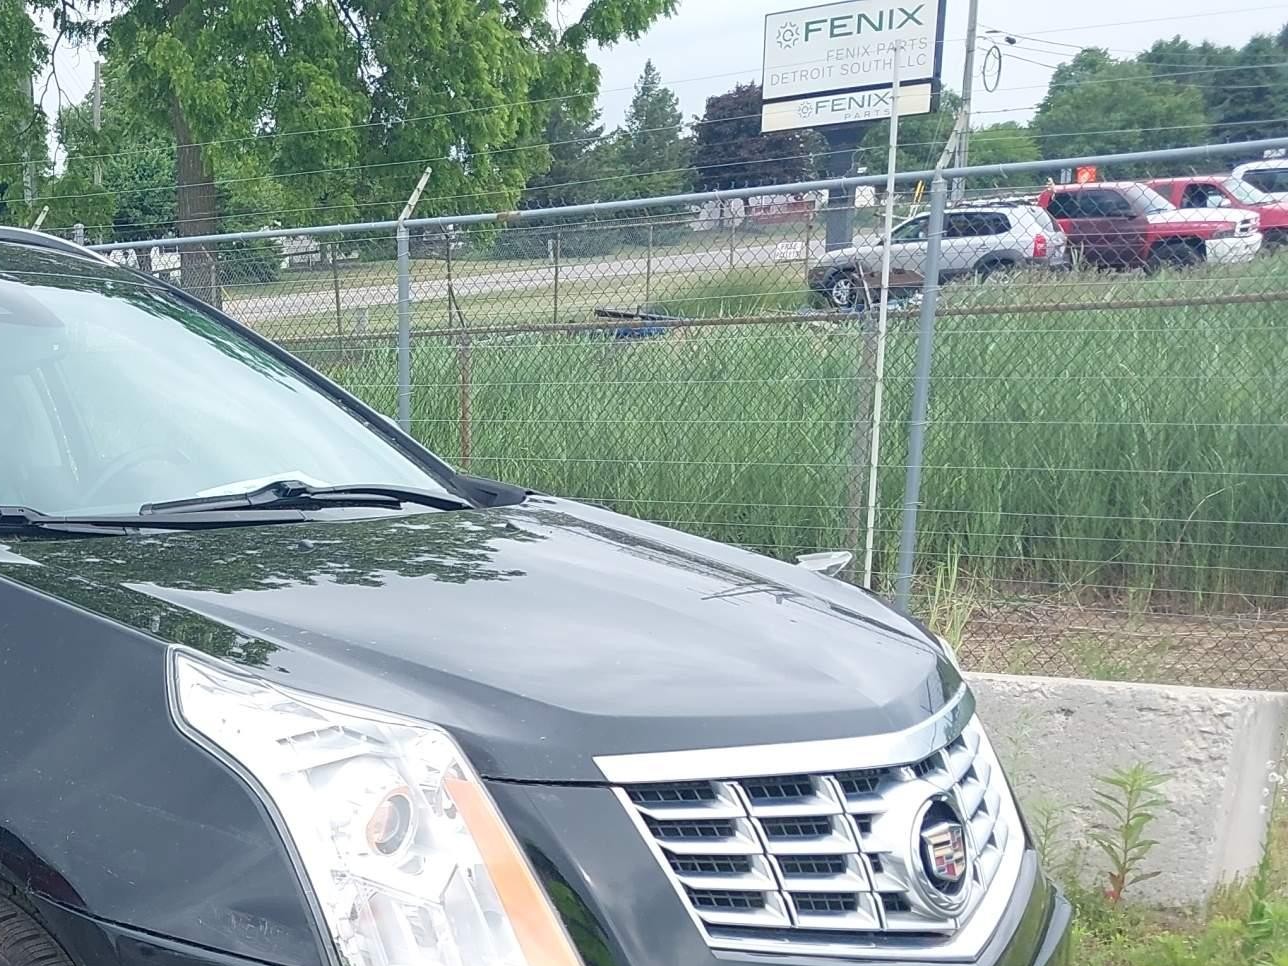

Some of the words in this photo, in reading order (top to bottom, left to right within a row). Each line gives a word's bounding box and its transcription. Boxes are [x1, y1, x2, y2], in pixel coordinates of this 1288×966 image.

[804, 3, 926, 42] FENIX
[826, 44, 875, 62] FENIX
[876, 37, 928, 56] PARTS
[770, 65, 835, 87] DETROIT
[840, 58, 893, 76] SOUTH
[815, 91, 890, 115] FENIX
[844, 108, 891, 121] PARTS
